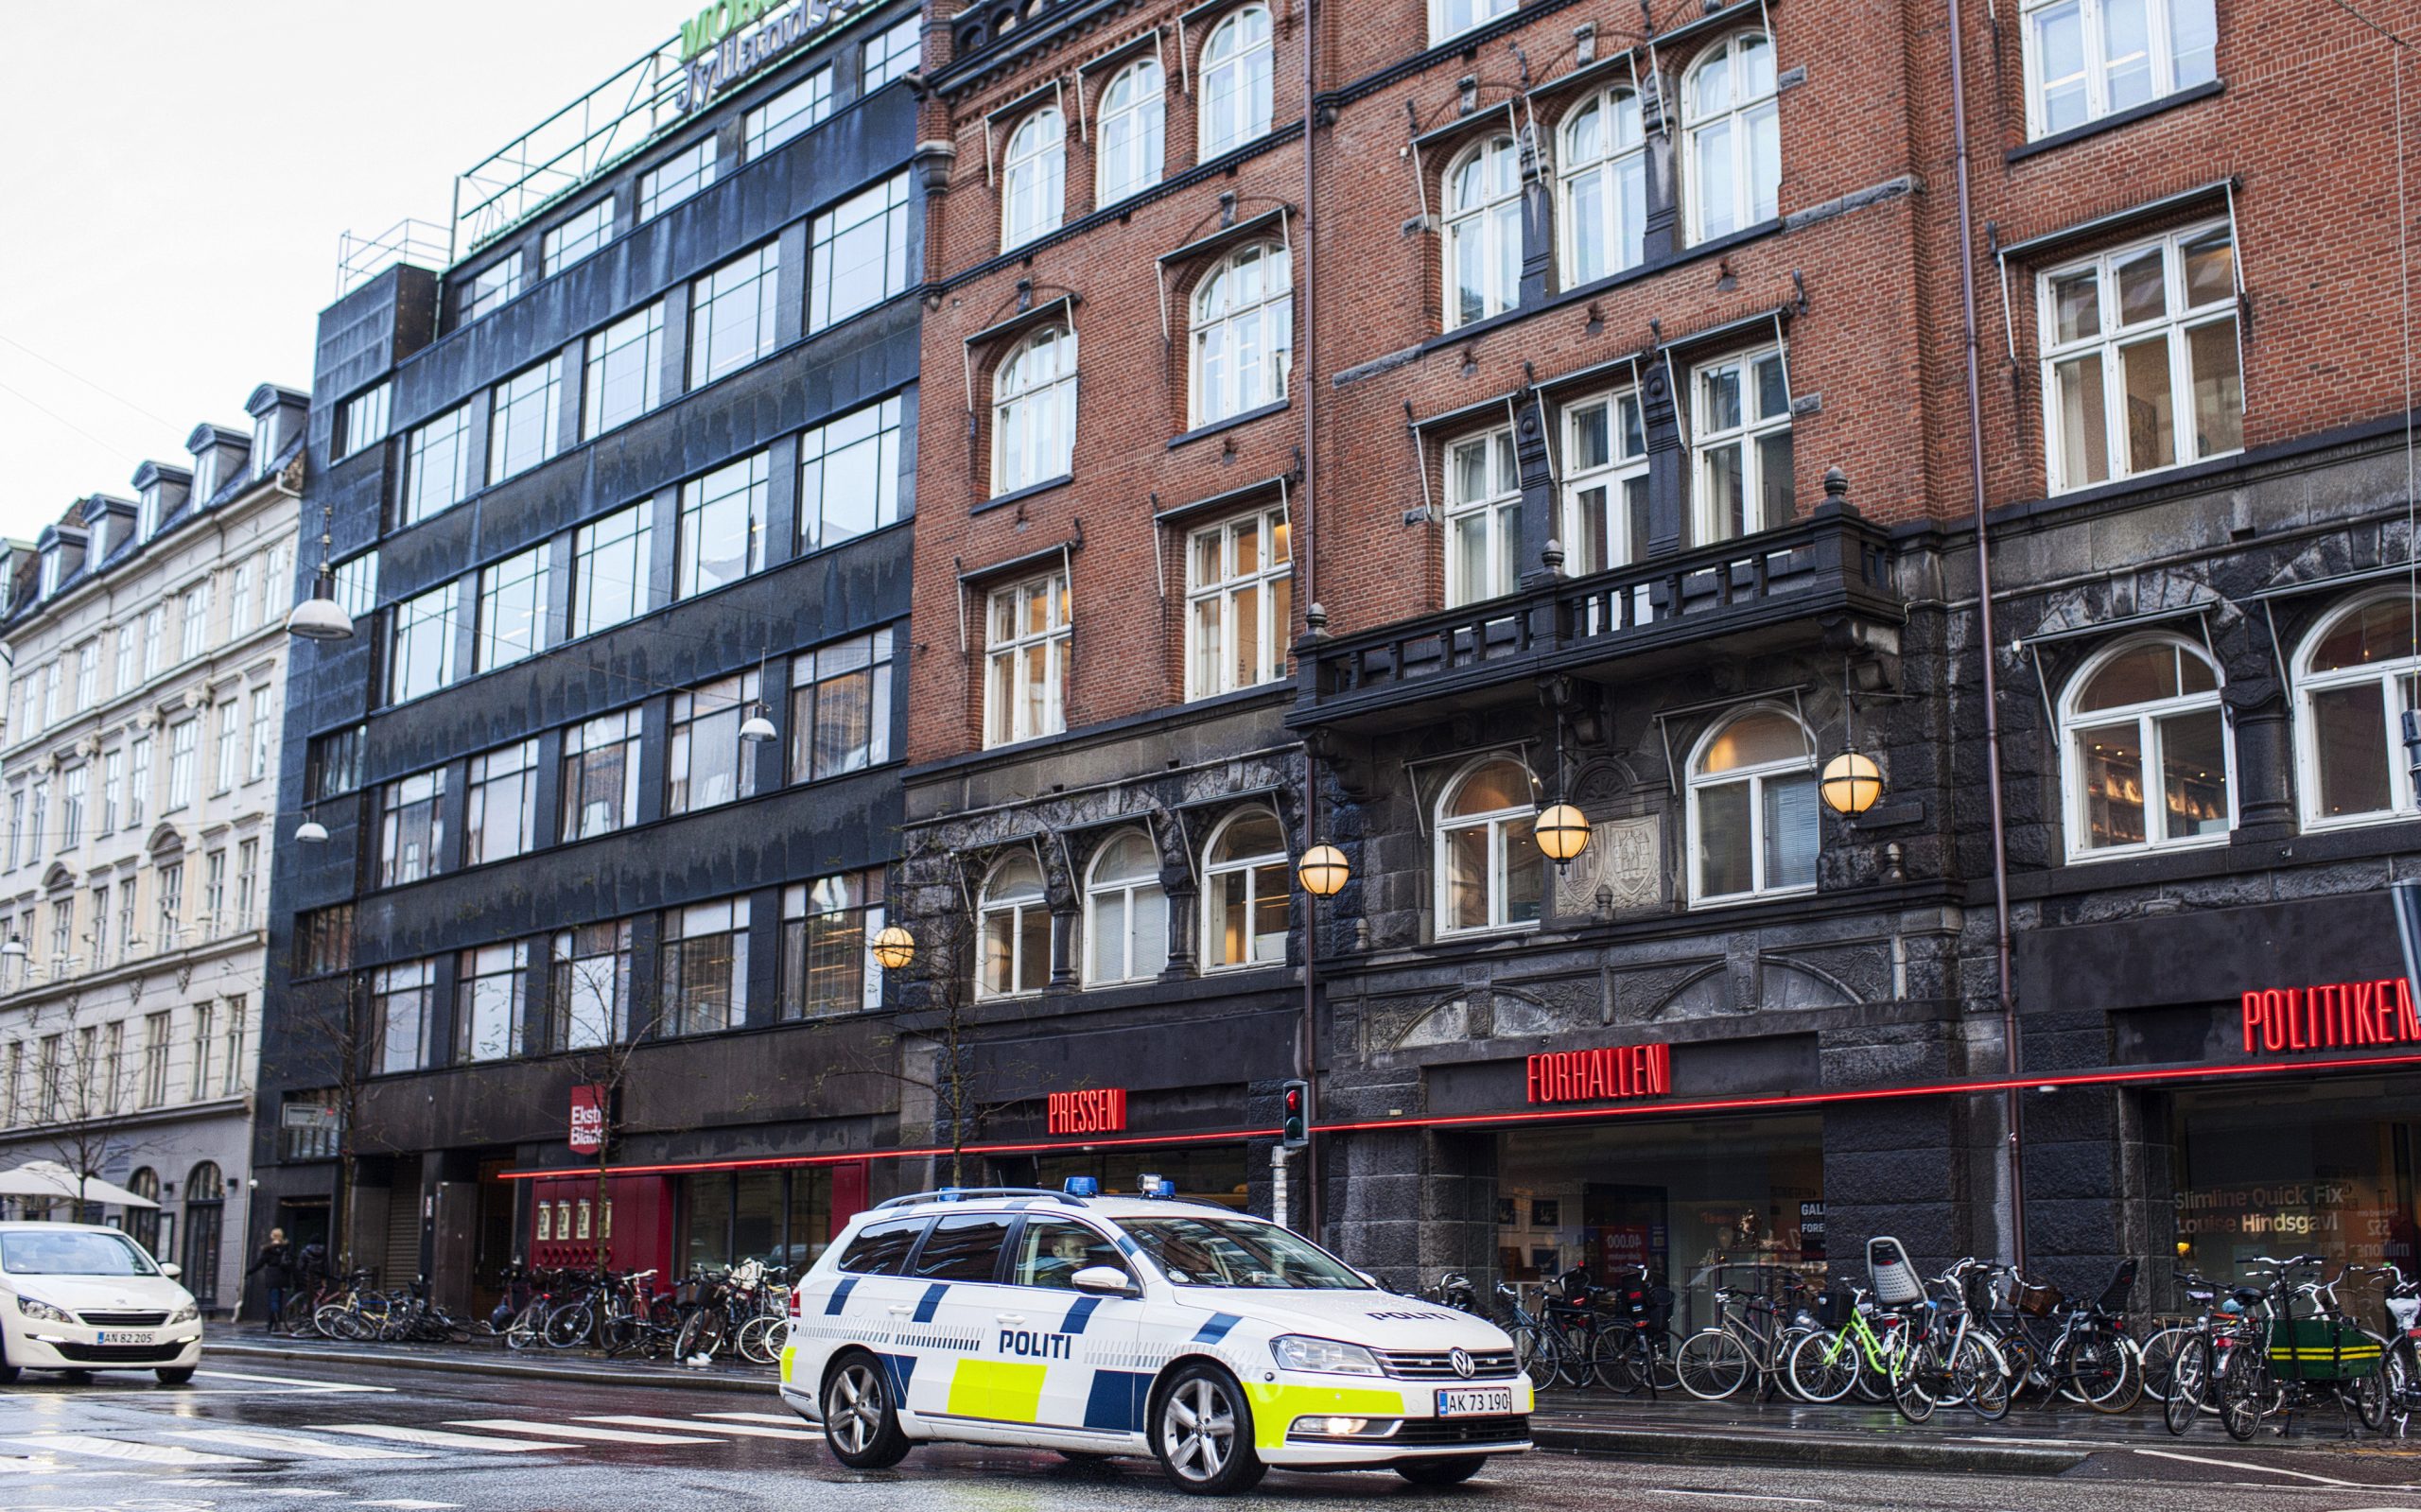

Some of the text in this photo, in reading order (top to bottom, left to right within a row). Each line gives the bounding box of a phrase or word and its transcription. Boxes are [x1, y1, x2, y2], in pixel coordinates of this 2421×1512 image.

[676, 0, 862, 113] Jyllands-
[2242, 978, 2421, 1052] POLITIKEN
[1527, 1043, 1670, 1103] FORHALLEN
[571, 1104, 608, 1125] Ekstr
[1049, 1087, 1126, 1134] PRESSEN
[1801, 1203, 1826, 1216] GAL
[2175, 1185, 2343, 1210] Slimline Quick Fix
[2177, 1215, 2237, 1234] Louise
[2241, 1211, 2338, 1235] Hindsgavl
[1365, 1312, 1458, 1322] POLITI
[134, 1333, 152, 1344] 205
[999, 1330, 1071, 1359] POLITI
[1449, 1393, 1508, 1412] AK 73 190
